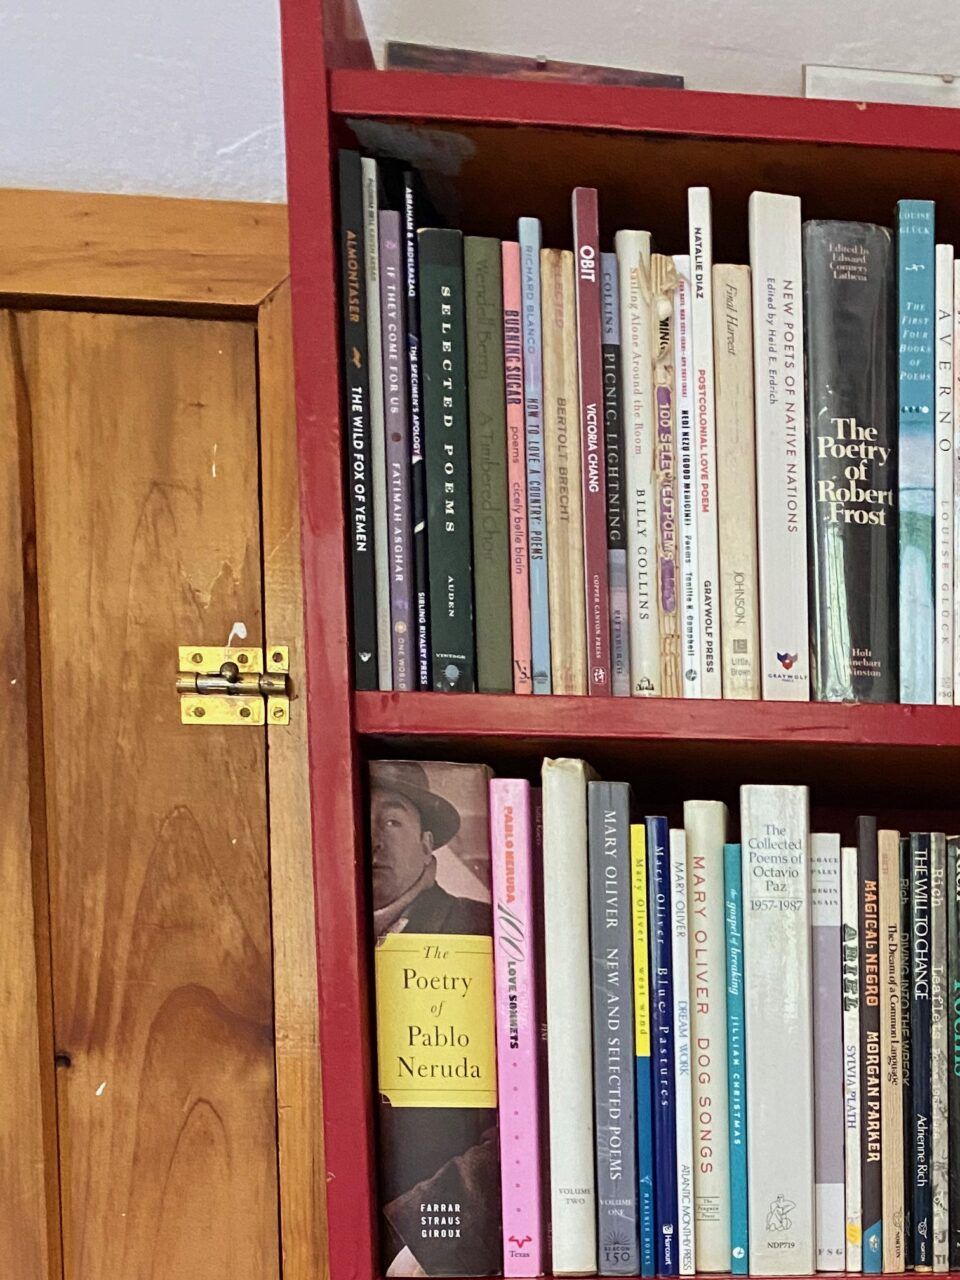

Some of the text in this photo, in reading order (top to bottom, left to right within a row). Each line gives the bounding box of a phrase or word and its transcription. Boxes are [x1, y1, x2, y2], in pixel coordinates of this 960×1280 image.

[580, 245, 597, 282] OBIT
[346, 231, 361, 323] ALMONTASER
[504, 311, 521, 405] BURNING SUGAR
[441, 285, 456, 534] SELECTED POEMS
[698, 369, 710, 514] POSTCOLONIAL LOVE POEM
[831, 418, 879, 441] The
[587, 403, 600, 494] VICTORIA CHANG
[604, 353, 621, 542] PICNIC, LIGHTNING
[817, 436, 891, 466] Poetry
[351, 387, 368, 553] THE WILD FOX OF YEMEN
[844, 459, 869, 481] of
[818, 481, 894, 506] Robert
[831, 501, 887, 526] Frost
[636, 489, 650, 621] BILLY COLLINS
[766, 824, 787, 837] The
[748, 838, 803, 851] Collected
[749, 852, 803, 866] Poems of
[753, 866, 799, 880] Octavio
[765, 881, 787, 894] Paz
[750, 900, 804, 913] 1957-1987
[424, 945, 450, 958] The
[865, 880, 879, 1006] MAGICAL NEGRO
[402, 966, 473, 997] Poetry
[603, 811, 622, 1180] MARY OLIVER NEW AND SELECTED POEMS
[430, 1000, 446, 1017] of
[692, 855, 713, 1174] MARY OLIVER DOG SONGS
[407, 1025, 471, 1048] Pablo
[397, 1056, 482, 1080] Neruda
[866, 1031, 880, 1162] MORGAN PARKER
[420, 1203, 461, 1212] FARRAR
[421, 1216, 461, 1225] STRAUS
[421, 1229, 461, 1238] GIROUX
[767, 1241, 797, 1250] NDP719
